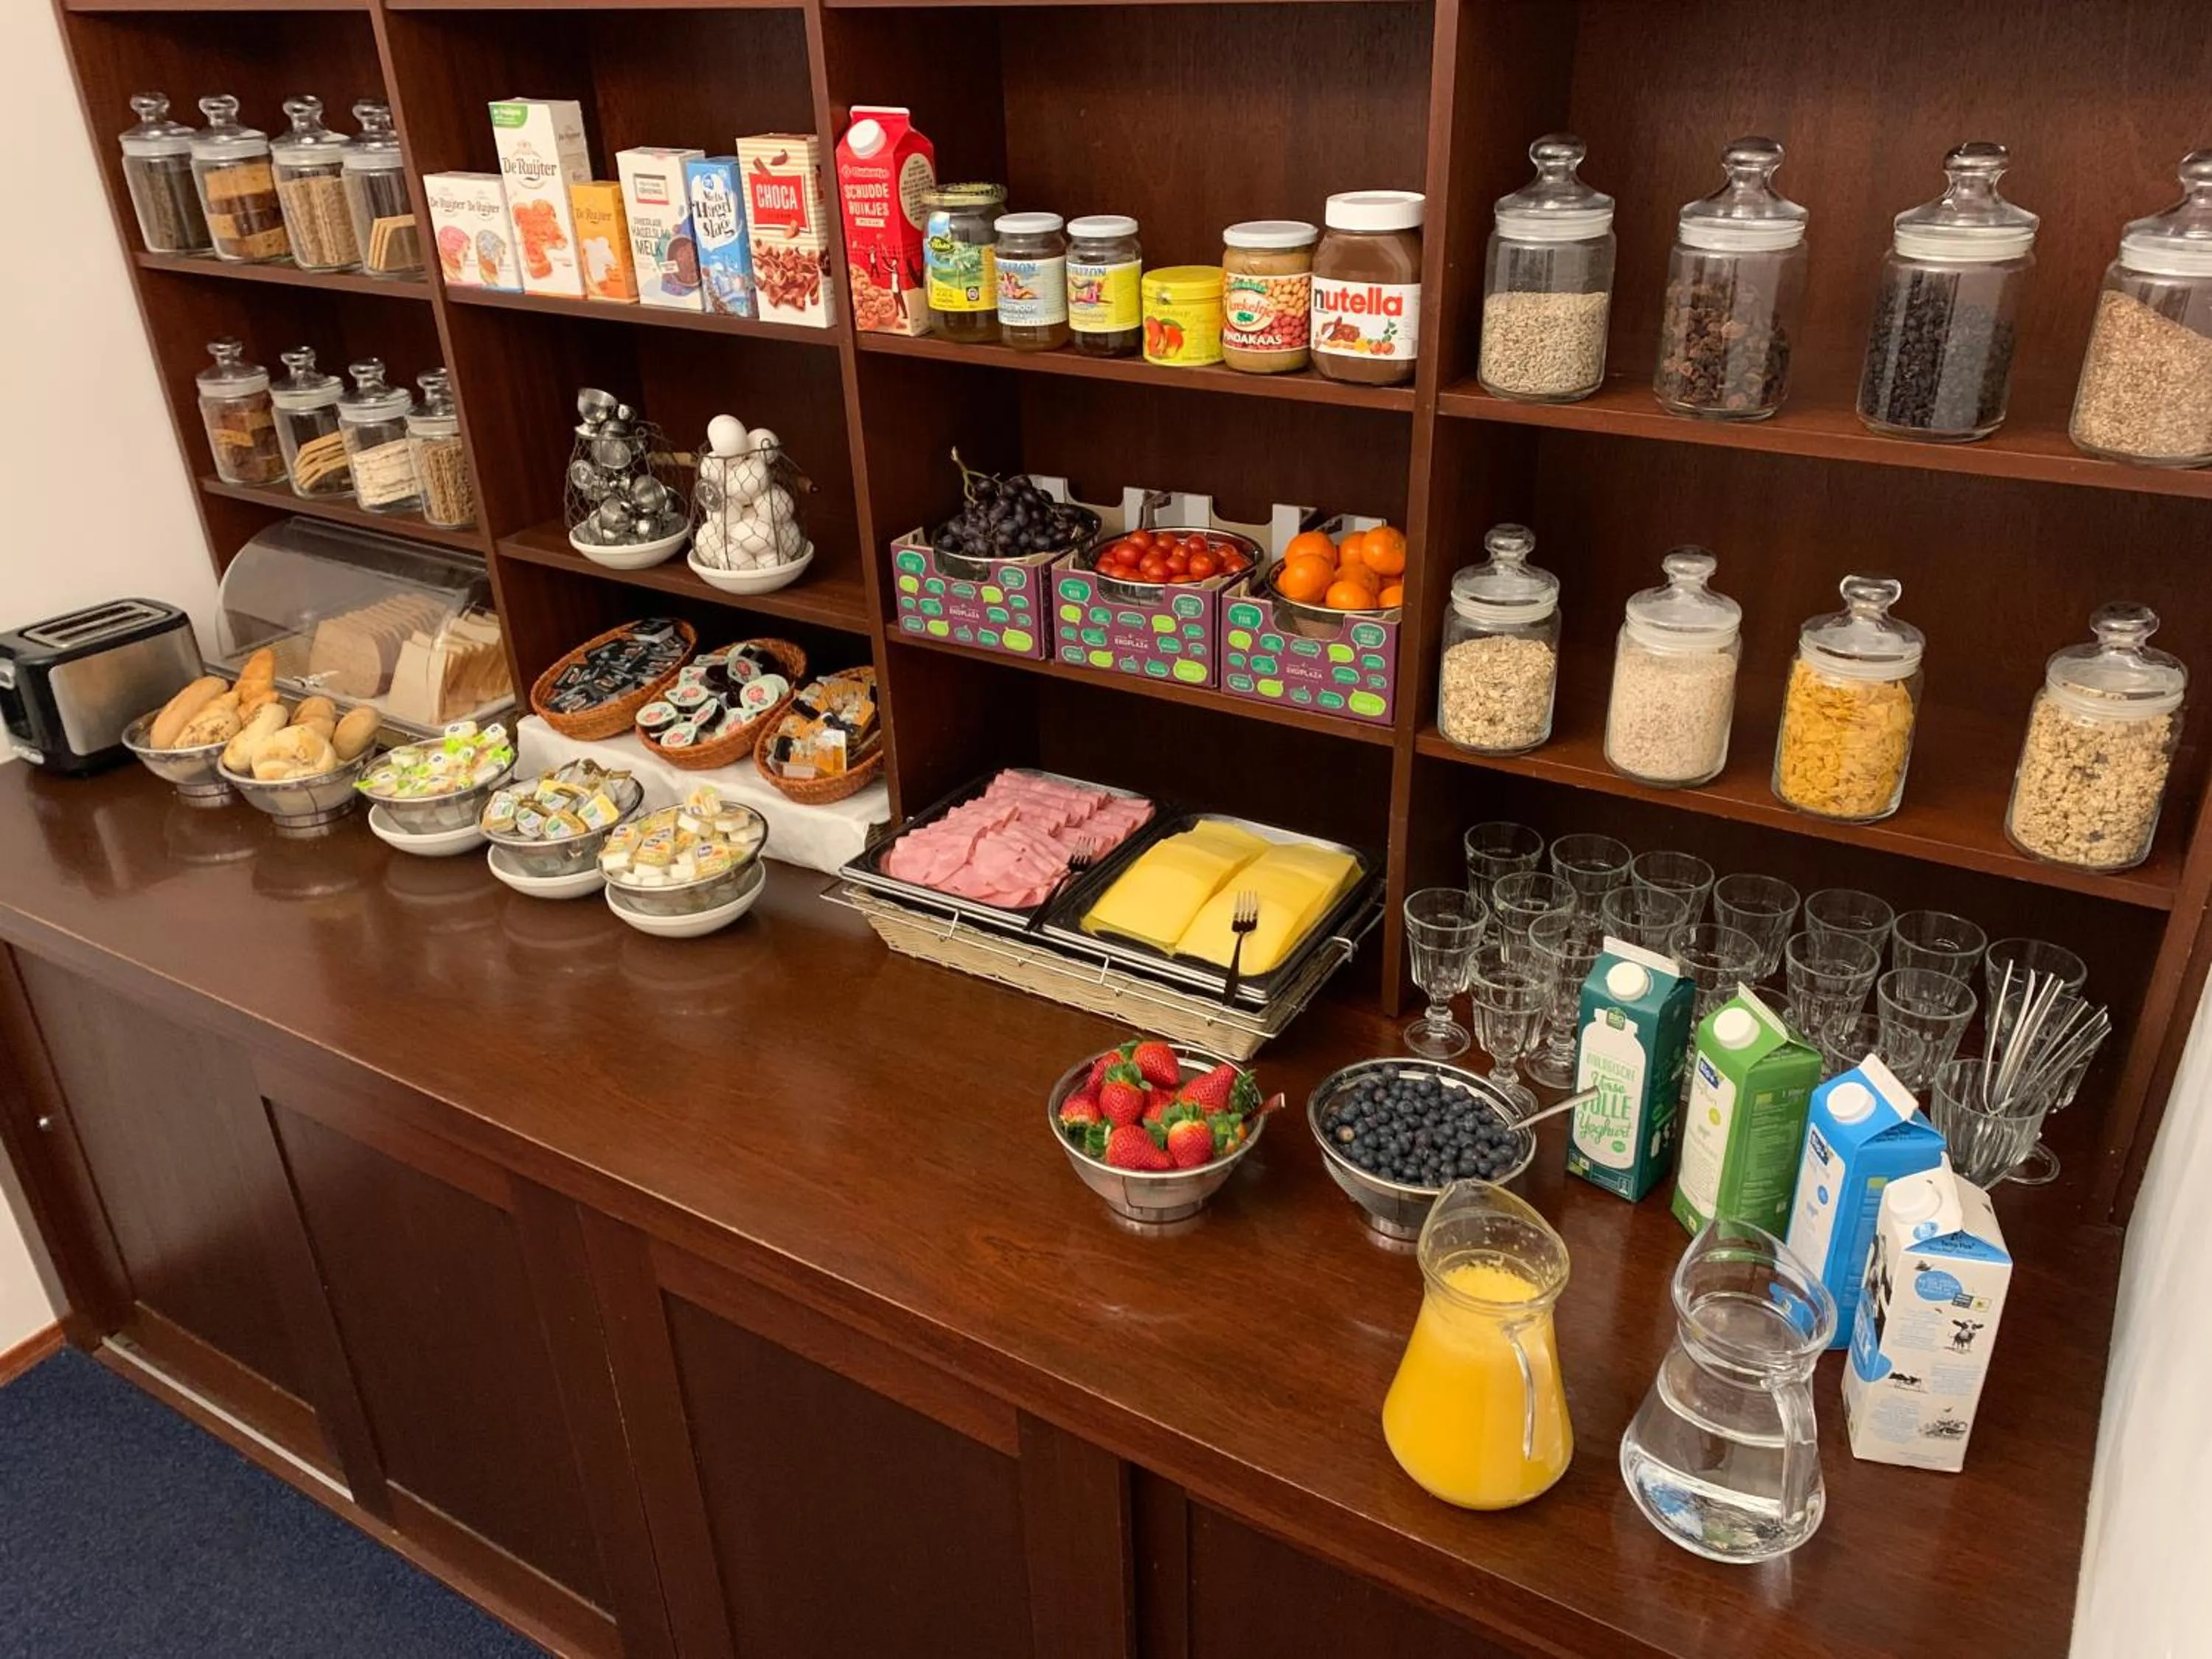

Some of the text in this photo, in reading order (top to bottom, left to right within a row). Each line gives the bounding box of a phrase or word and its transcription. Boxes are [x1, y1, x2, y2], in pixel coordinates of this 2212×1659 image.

[501, 158, 557, 179] De Ruijter
[430, 196, 439, 208] De
[756, 184, 799, 210] CHOCA
[1315, 288, 1402, 316] nutella
